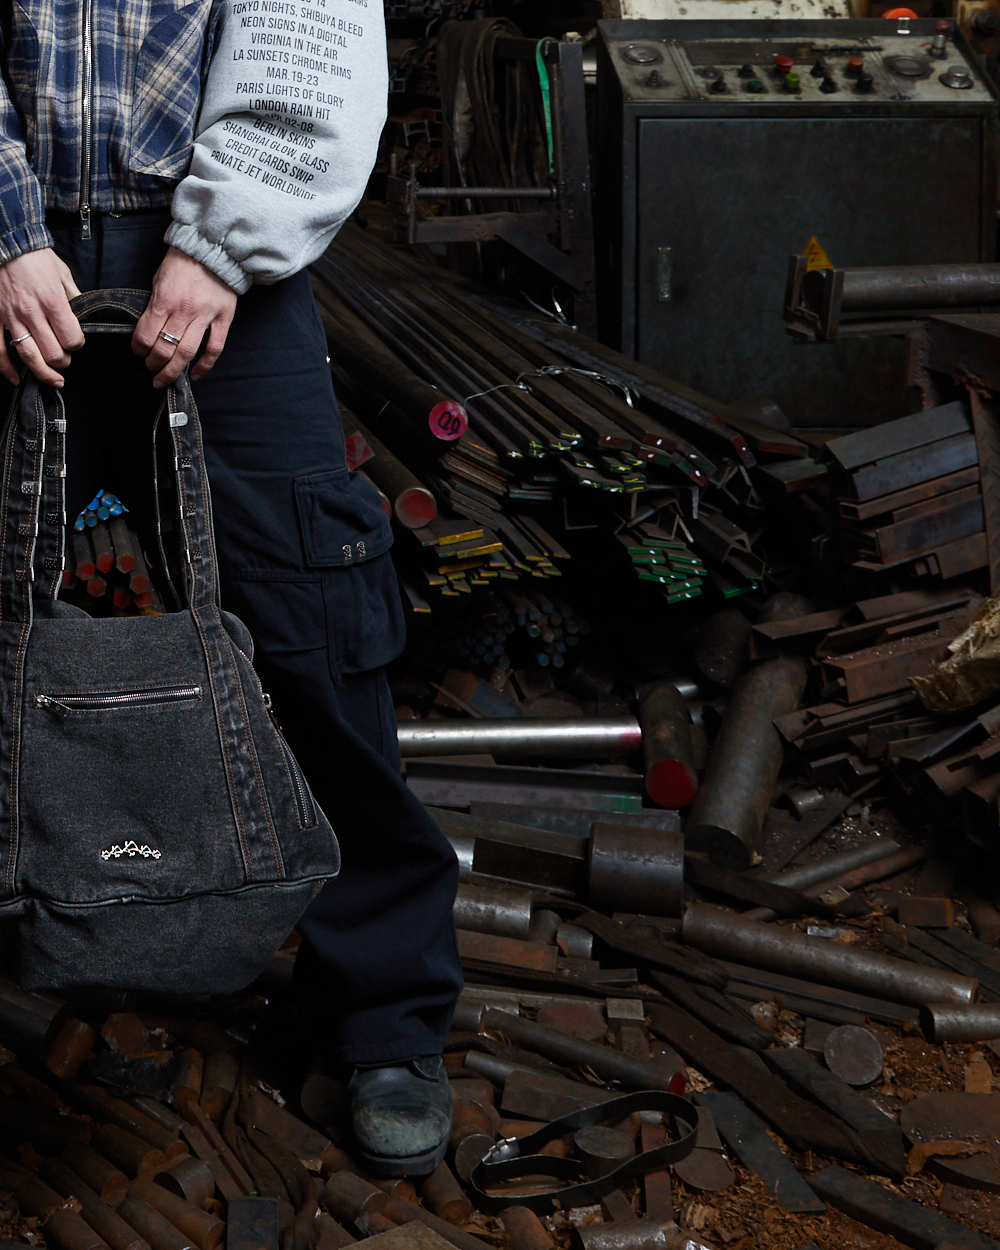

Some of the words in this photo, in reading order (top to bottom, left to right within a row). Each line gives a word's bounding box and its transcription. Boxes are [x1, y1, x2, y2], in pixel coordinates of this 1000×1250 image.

[233, 0, 259, 15] TOKYO
[262, 0, 298, 17] NIGHTS,
[300, 7, 336, 28] SHIBUYA
[338, 19, 364, 37] BLEED
[240, 16, 266, 28] NEON
[268, 18, 296, 32] SIGNS
[298, 22, 308, 34] IN
[308, 26, 314, 38] A
[316, 28, 348, 48] DIGITAL
[252, 32, 292, 48] VIRGINIA
[294, 38, 304, 50] IN
[306, 40, 321, 56] THE
[324, 48, 338, 60] AIR
[233, 49, 244, 61] LA
[246, 49, 290, 64] SUNSETS
[292, 54, 328, 74] CHROME
[330, 64, 352, 80] RIMS
[236, 82, 264, 94] PARIS
[266, 83, 300, 98] LIGHTS
[302, 88, 314, 100] OF
[316, 92, 344, 108] GLORY
[250, 99, 288, 114] LONDON
[290, 102, 314, 118] RAIN
[316, 106, 330, 120] HIT
[223, 122, 270, 146] SHANGHAI
[270, 140, 298, 160] GLOW,
[300, 152, 330, 173] GLASS
[254, 118, 288, 140] BERLIN
[287, 131, 316, 150] SKINS
[210, 150, 246, 172] PRIVATE
[244, 164, 262, 179] JET
[226, 138, 260, 158] CREDIT
[258, 152, 290, 174] CARDS
[290, 166, 314, 184] SWIP
